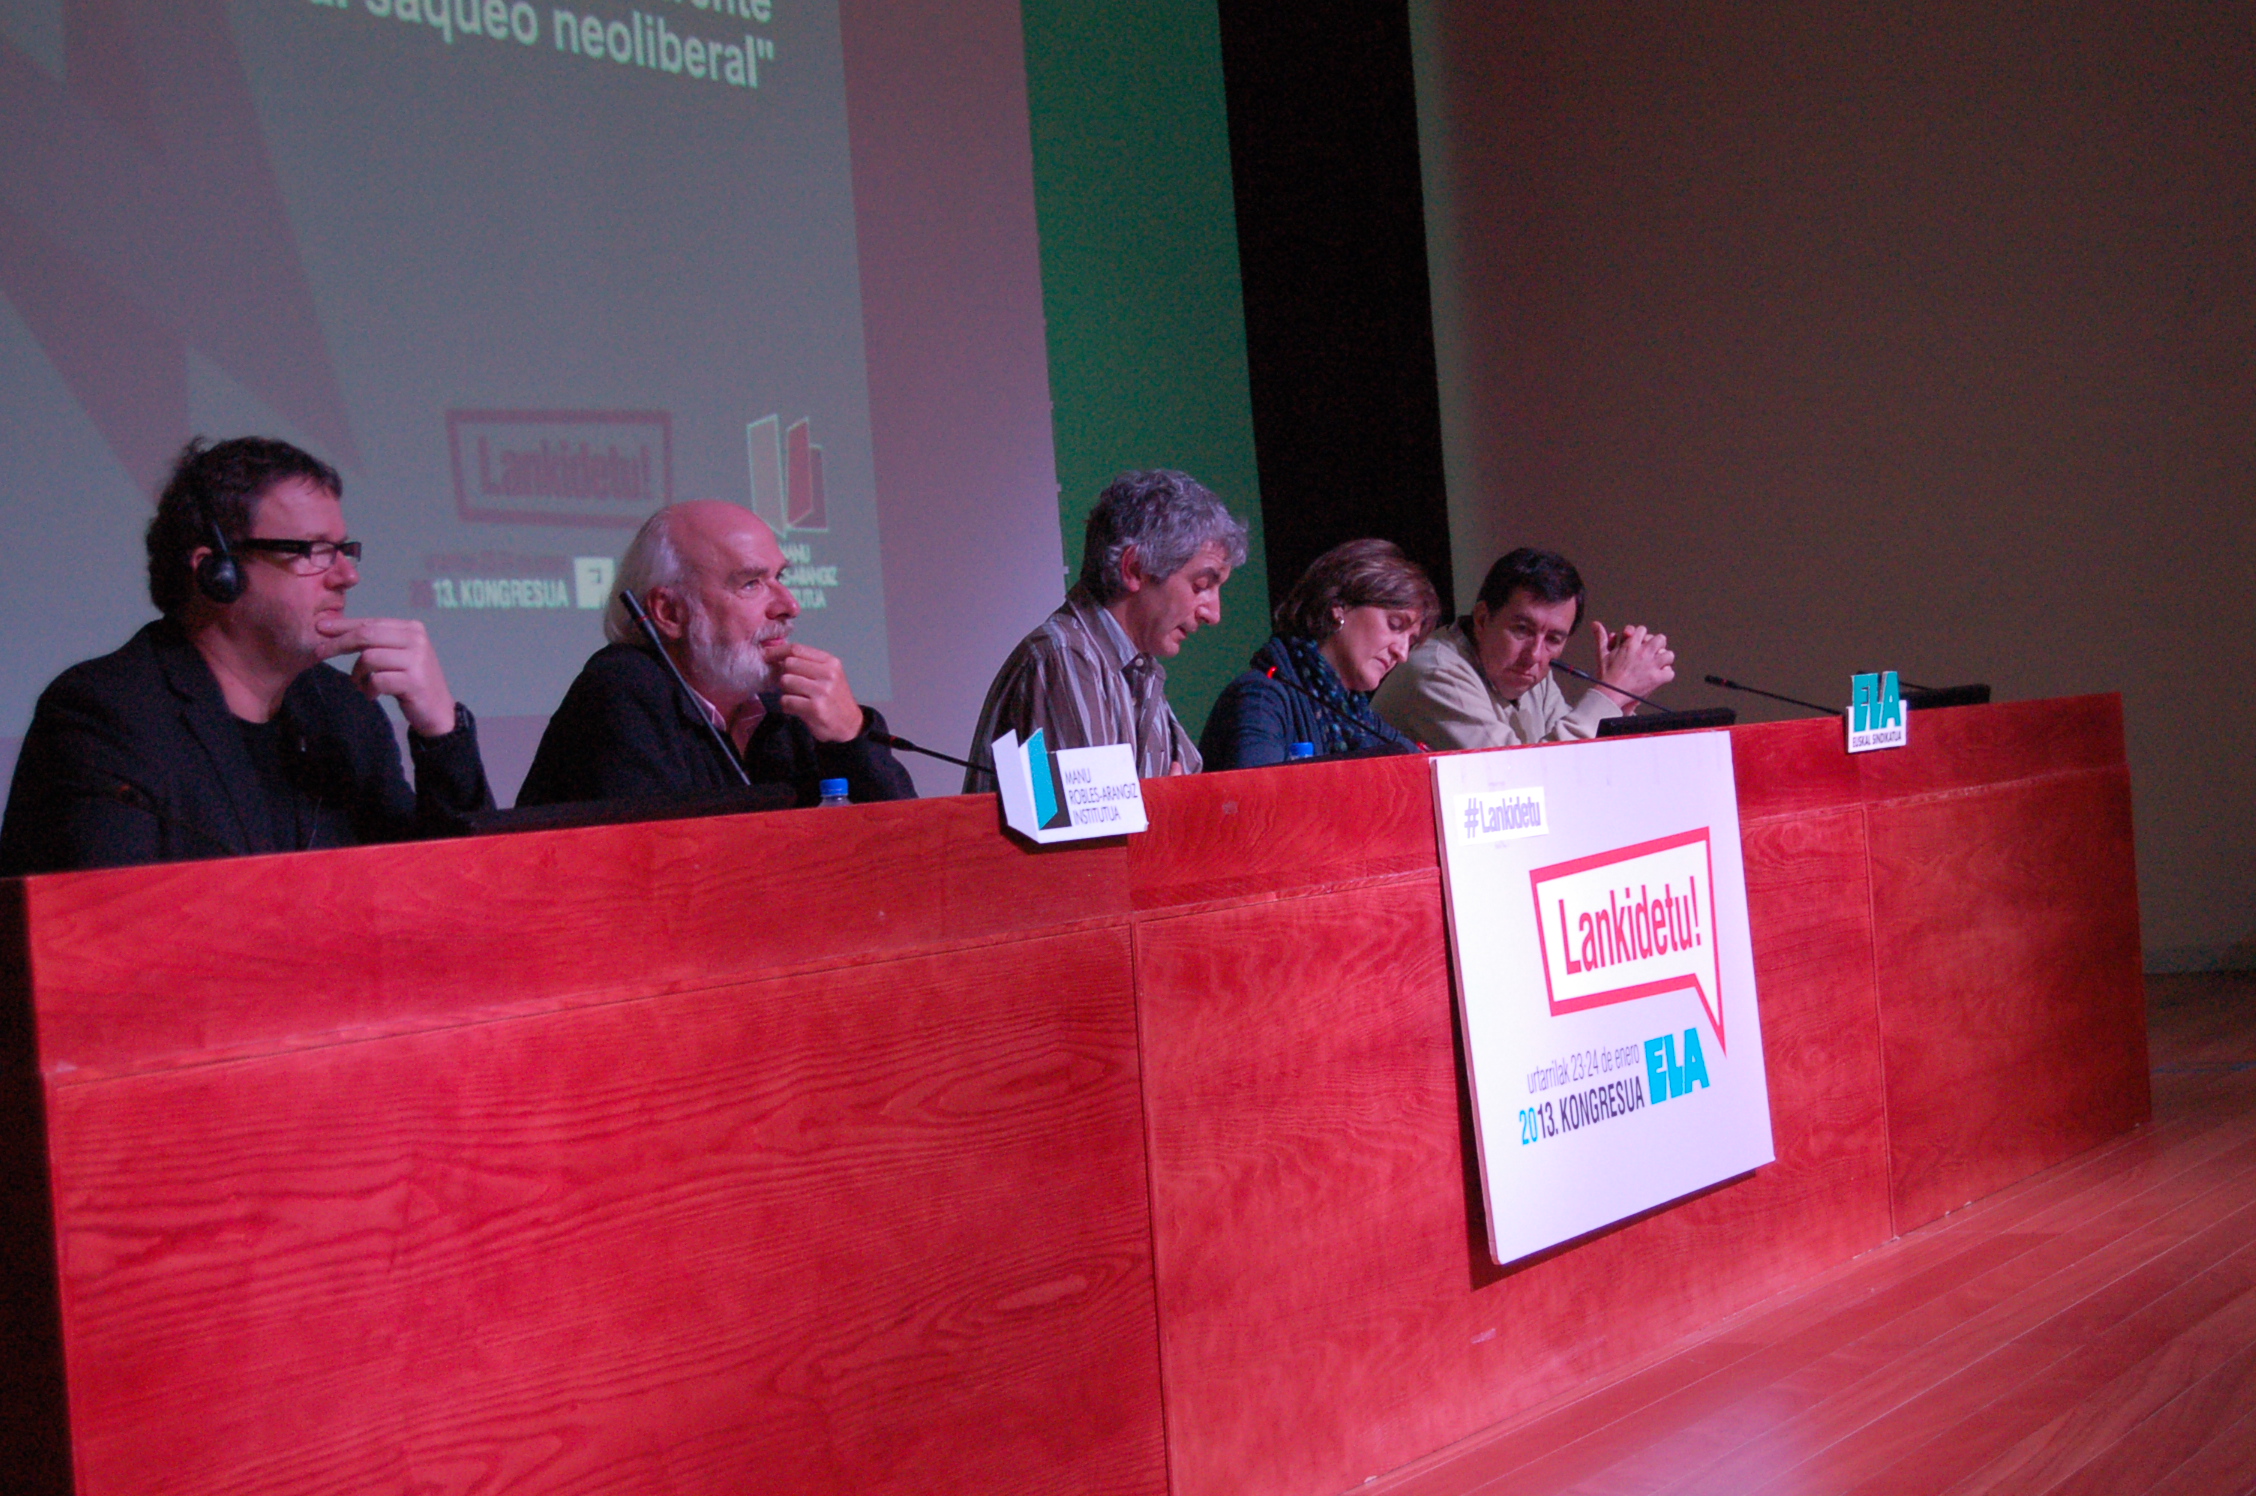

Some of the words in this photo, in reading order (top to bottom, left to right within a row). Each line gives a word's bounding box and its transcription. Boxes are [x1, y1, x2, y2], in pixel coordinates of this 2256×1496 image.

[553, 9, 775, 89] neoliberal"
[477, 434, 653, 500] Lankidetu!
[459, 578, 570, 609] KONGRESUA
[1852, 671, 1902, 732] ELA
[1852, 735, 1871, 748] EUSKAL
[1065, 767, 1092, 785] MANU
[1069, 783, 1138, 805] ROBLES-ARANGIZ
[1073, 805, 1121, 826] INSTITUTUA
[1464, 796, 1541, 839] #Lankidetu
[1558, 875, 1702, 975] Lankidetu!
[1526, 1057, 1570, 1094] urtarrilak
[1570, 1050, 1599, 1082] 23-24
[1600, 1046, 1613, 1073] de
[1614, 1044, 1640, 1070] enero
[1643, 1027, 1710, 1105] ELA
[1559, 1075, 1645, 1138] KONGRESUA
